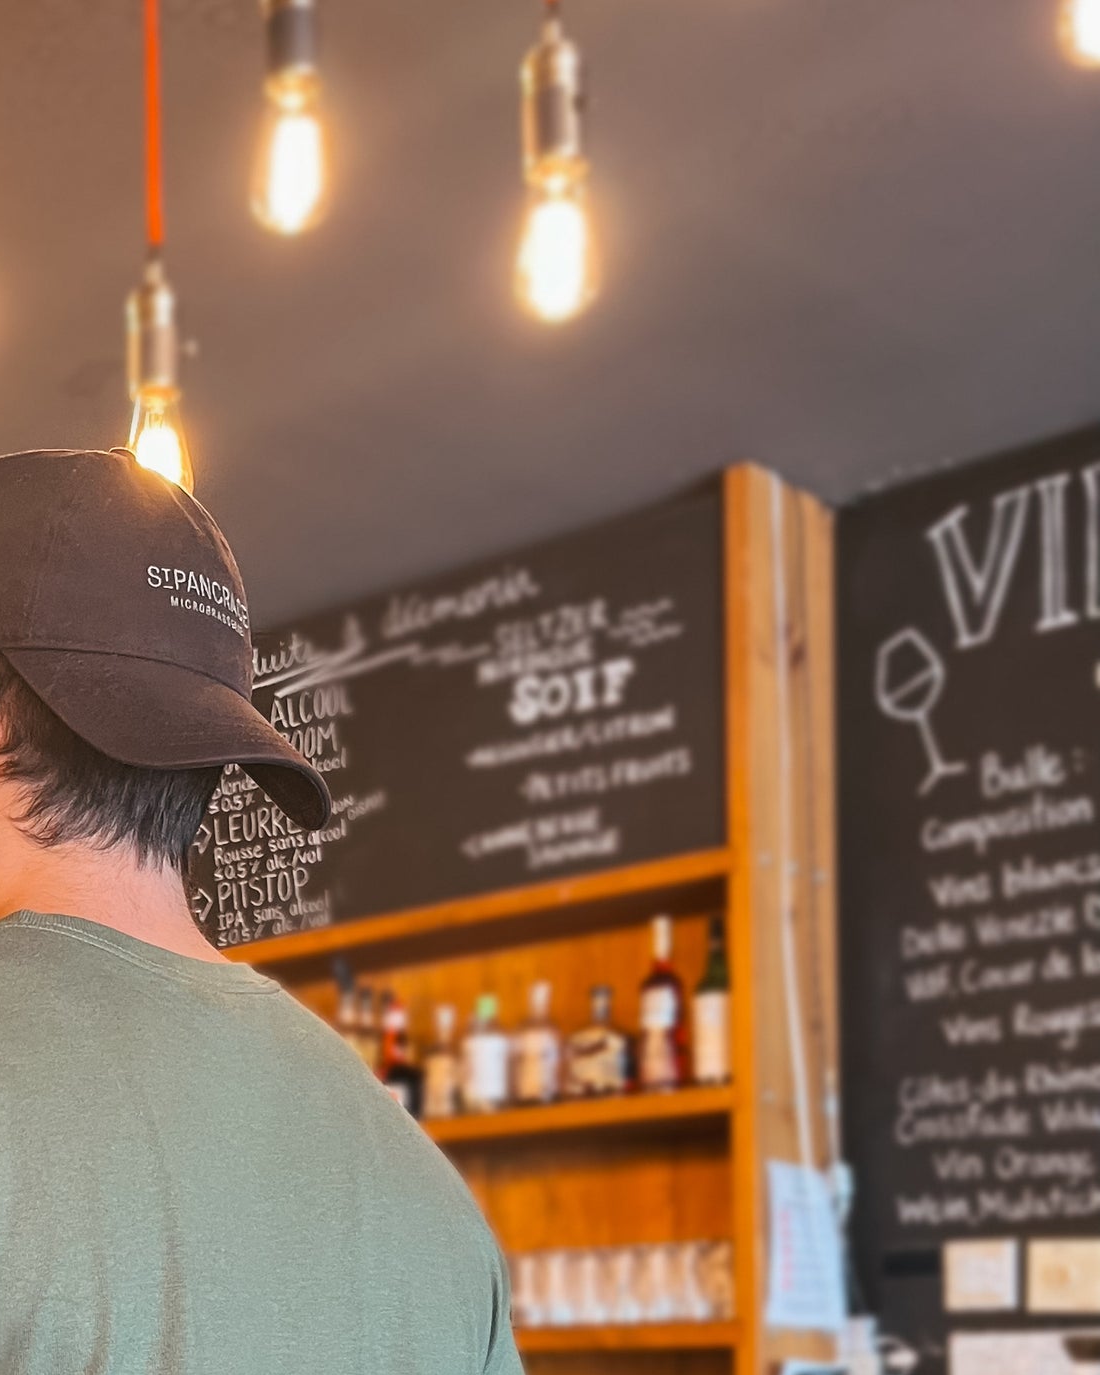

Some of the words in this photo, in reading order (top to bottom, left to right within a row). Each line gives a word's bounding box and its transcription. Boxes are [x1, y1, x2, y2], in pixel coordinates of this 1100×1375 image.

[271, 684, 353, 728] ALCOOL
[509, 659, 635, 725] SOIF
[267, 835, 306, 853] sans
[306, 819, 347, 846] alcool
[921, 796, 1093, 856] Composition
[217, 866, 310, 915] PITSTOP
[217, 911, 250, 931] IPA
[253, 906, 284, 924] sans
[934, 1150, 982, 1180] Vin
